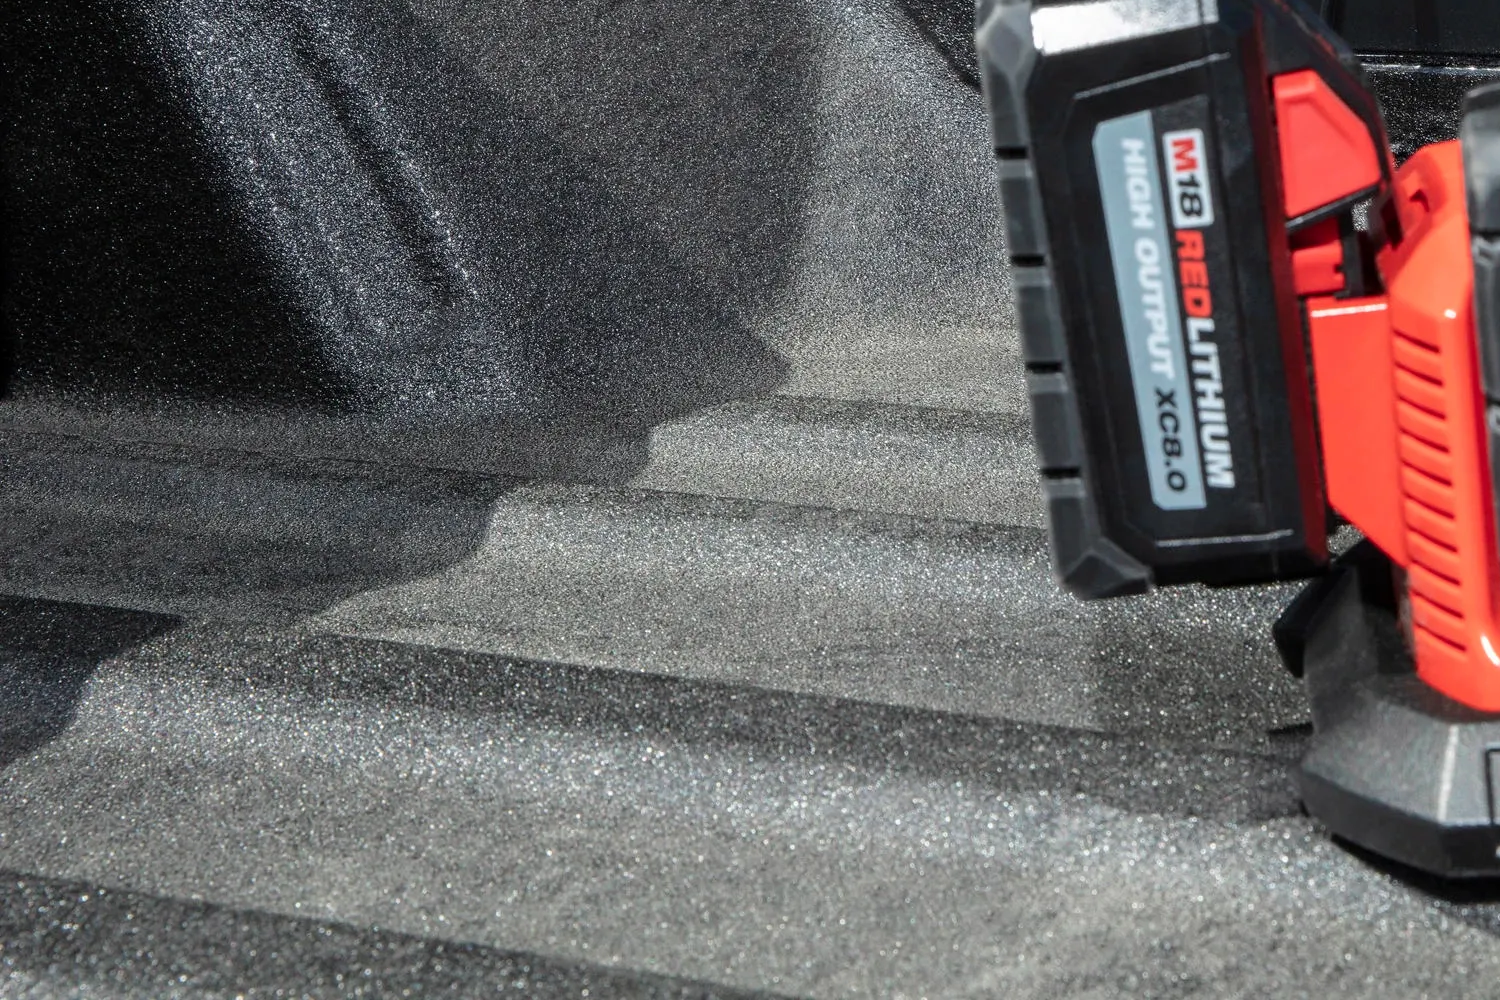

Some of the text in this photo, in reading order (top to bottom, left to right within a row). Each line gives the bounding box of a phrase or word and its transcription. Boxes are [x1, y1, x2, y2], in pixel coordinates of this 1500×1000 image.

[1171, 137, 1205, 218] M18
[1121, 138, 1188, 492] HIGH OUTPUT XC8.0
